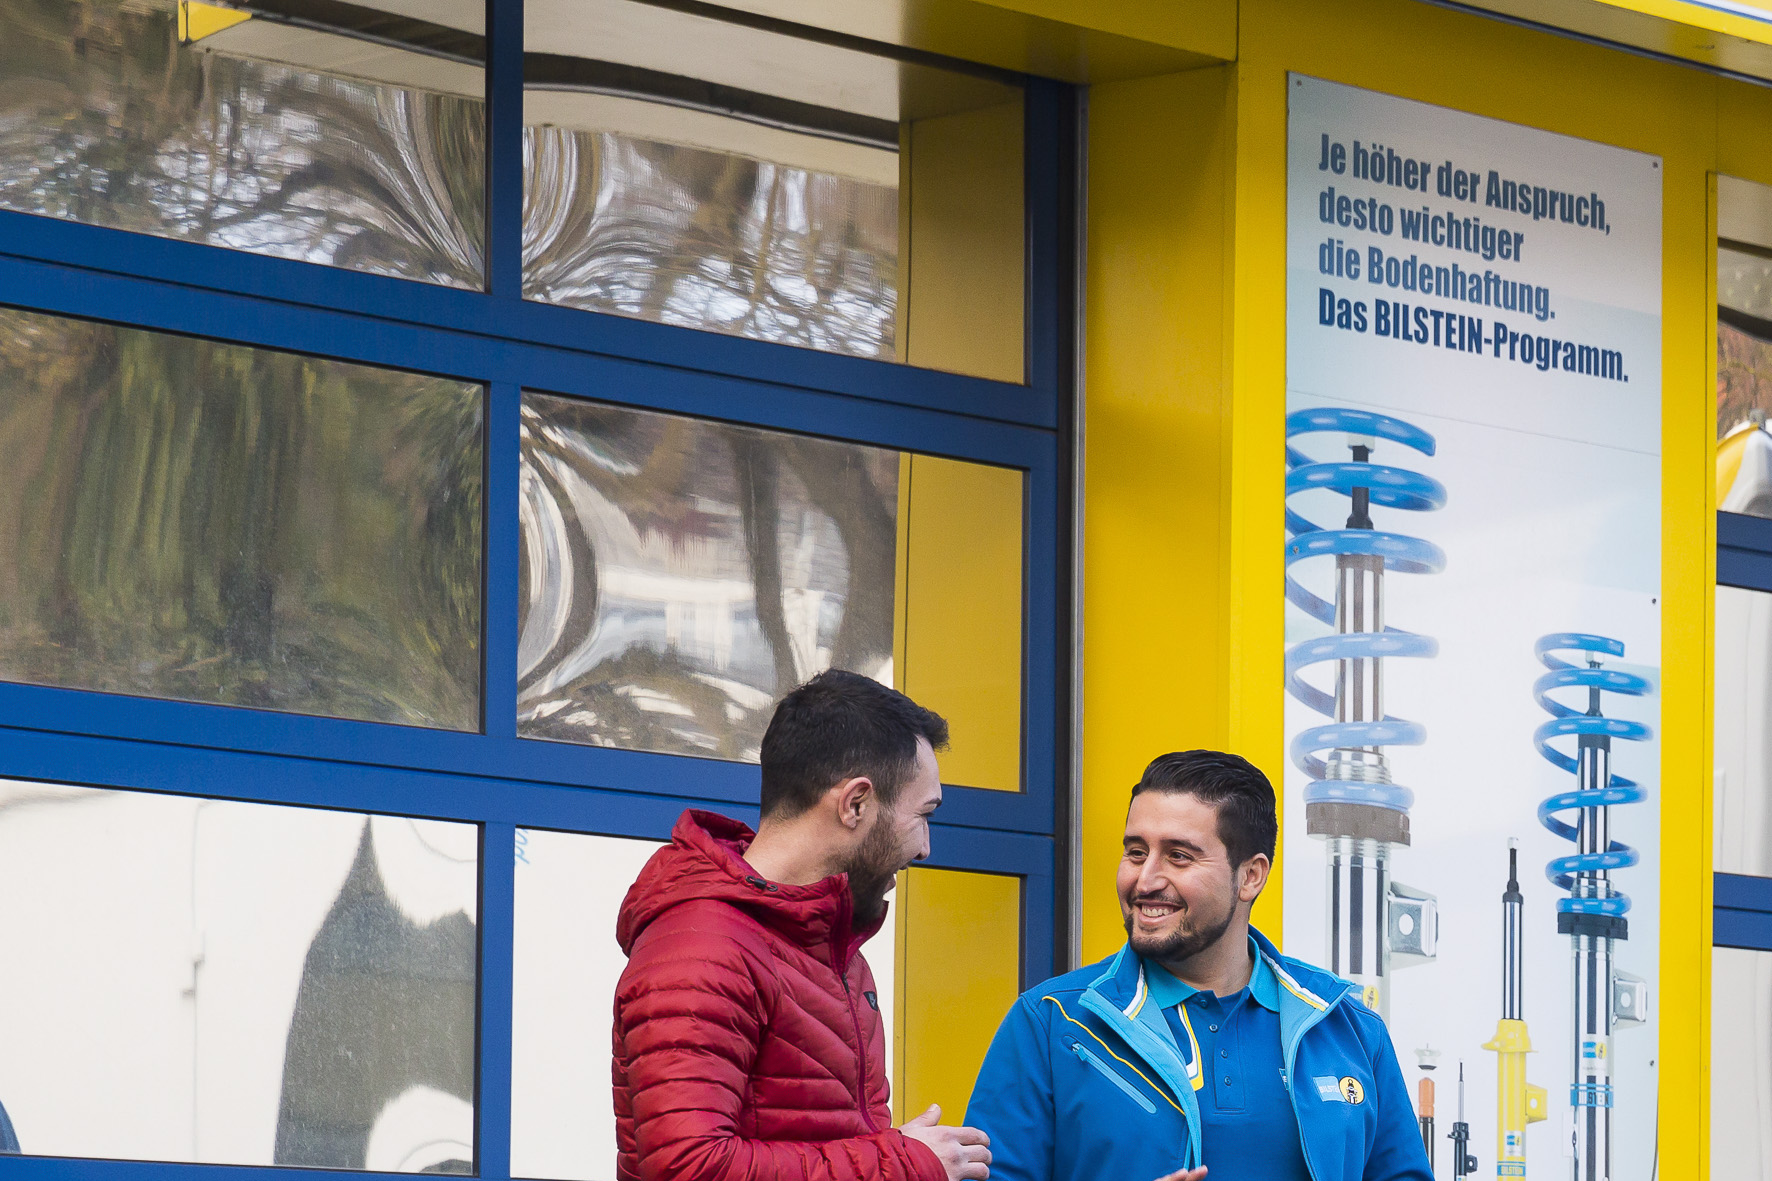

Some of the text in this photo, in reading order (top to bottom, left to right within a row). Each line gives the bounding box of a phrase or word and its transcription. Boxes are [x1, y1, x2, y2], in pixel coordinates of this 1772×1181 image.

[1318, 133, 1611, 235] Je höher der Anspruch,
[1319, 187, 1524, 262] desto wichtiger
[1319, 238, 1556, 322] die Bodenhaftung.
[1319, 288, 1629, 382] Das BILSTEIN-Programm.
